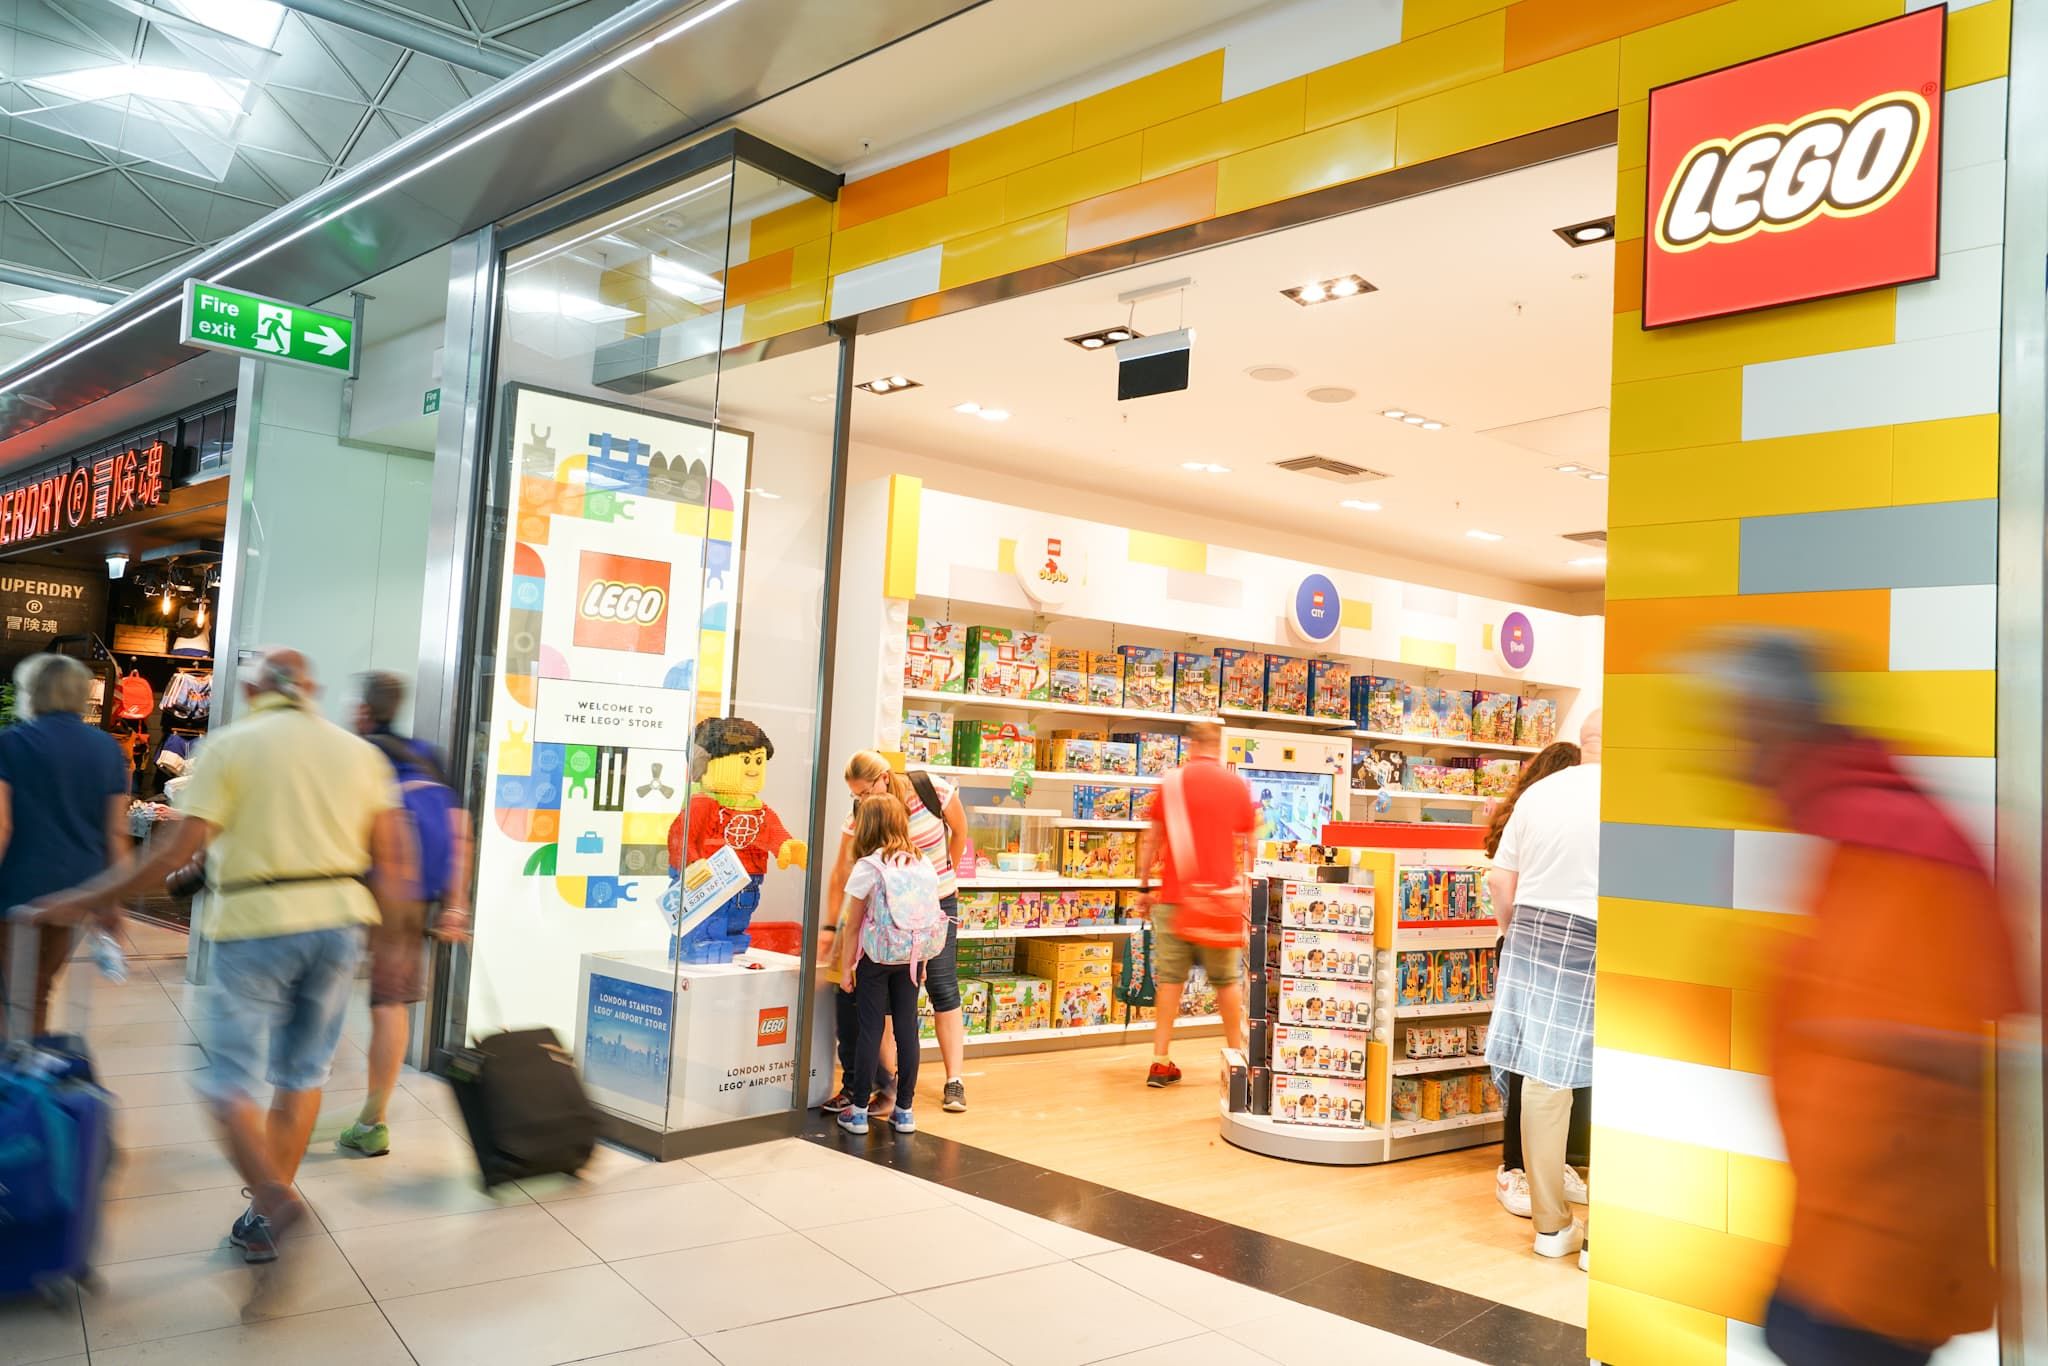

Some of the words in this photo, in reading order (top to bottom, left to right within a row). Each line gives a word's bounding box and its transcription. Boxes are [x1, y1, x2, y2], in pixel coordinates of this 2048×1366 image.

[1660, 97, 1923, 247] LEGO
[200, 293, 239, 317] Fire
[199, 319, 236, 340] exit
[0, 474, 68, 545] ERDRY
[1, 577, 85, 599] UPERDRY
[581, 580, 665, 625] LEGO
[1311, 608, 1325, 618] CITY
[578, 701, 633, 713] WELCOME
[639, 705, 653, 714] TO
[564, 714, 586, 724] THE
[628, 718, 664, 728] STORE
[599, 993, 627, 1007] LONDON
[629, 1000, 663, 1016] STANSTED
[614, 1011, 644, 1025] AIRPORT
[644, 1018, 668, 1031] STORE
[760, 1017, 787, 1034] LEGO
[727, 1064, 765, 1077] LONDON
[749, 1073, 787, 1087] AIRPORT
